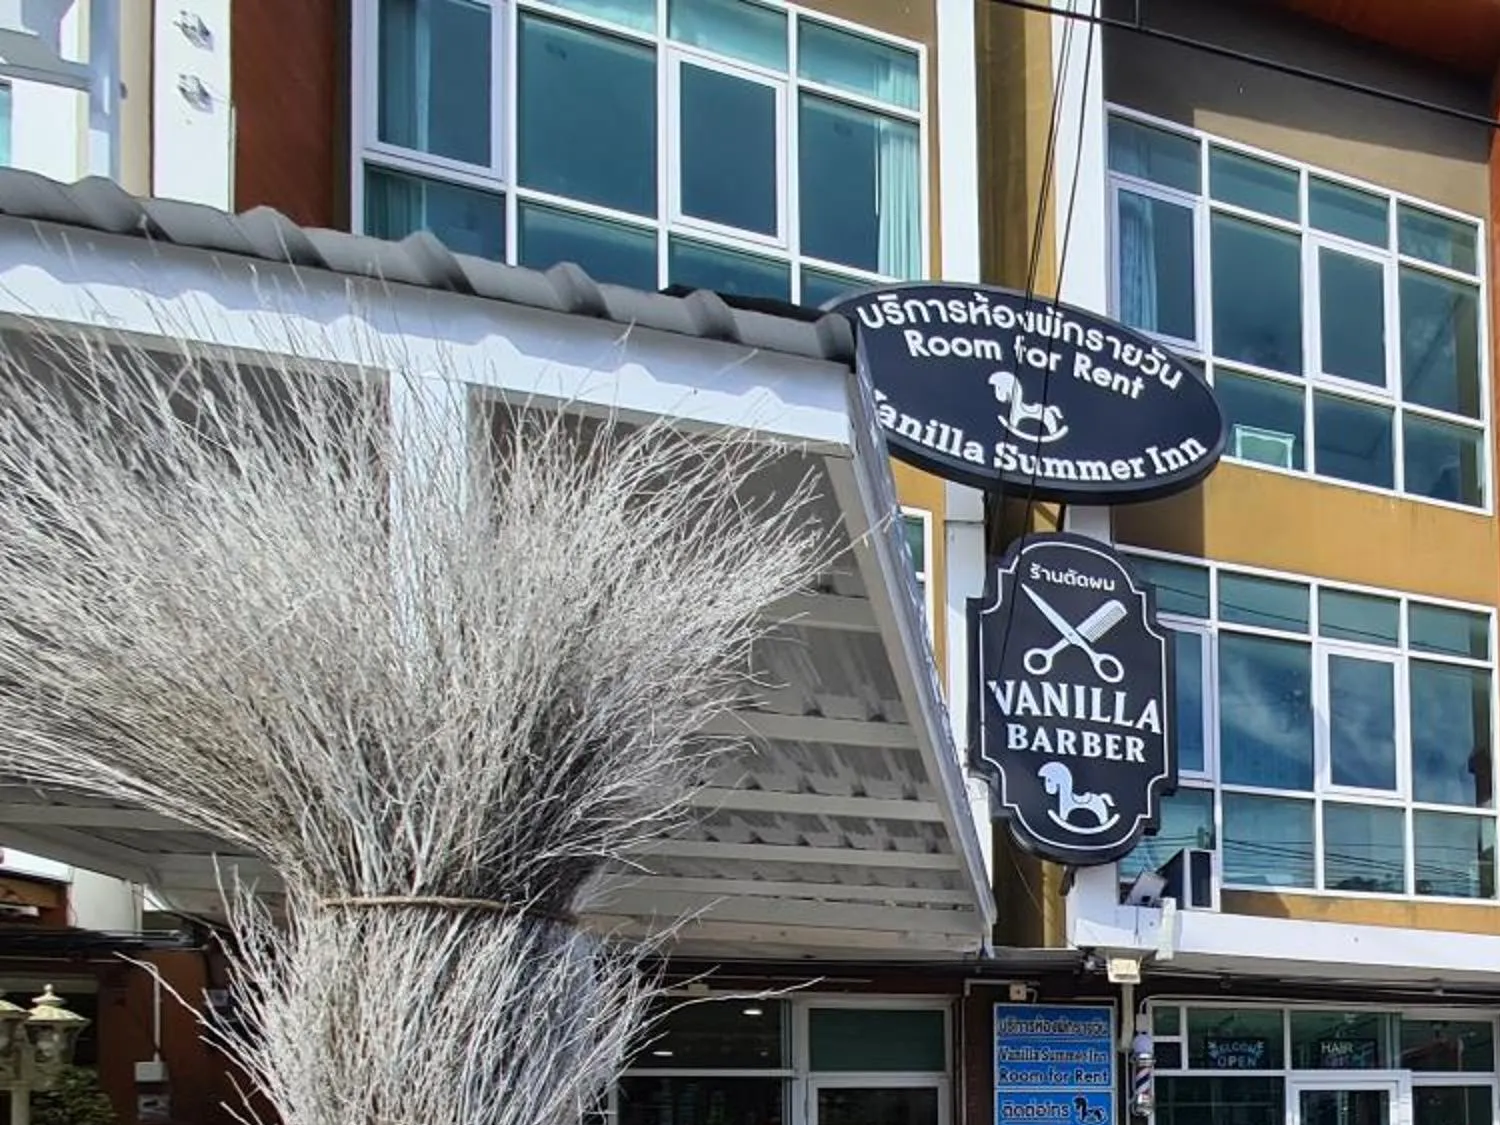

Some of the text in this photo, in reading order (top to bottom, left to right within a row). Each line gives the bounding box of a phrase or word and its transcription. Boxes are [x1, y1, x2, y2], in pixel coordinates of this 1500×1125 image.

[904, 330, 1145, 400] Room for Rent
[874, 388, 1207, 481] anilla Summer Inn
[1029, 562, 1116, 592] ร้านตัดผม
[989, 680, 1162, 734] VANILLA
[1007, 724, 1146, 763] BARBER
[1217, 1055, 1257, 1067] OPEN
[1320, 1041, 1353, 1055] HAIR
[1000, 1067, 1109, 1084] Room for Rent
